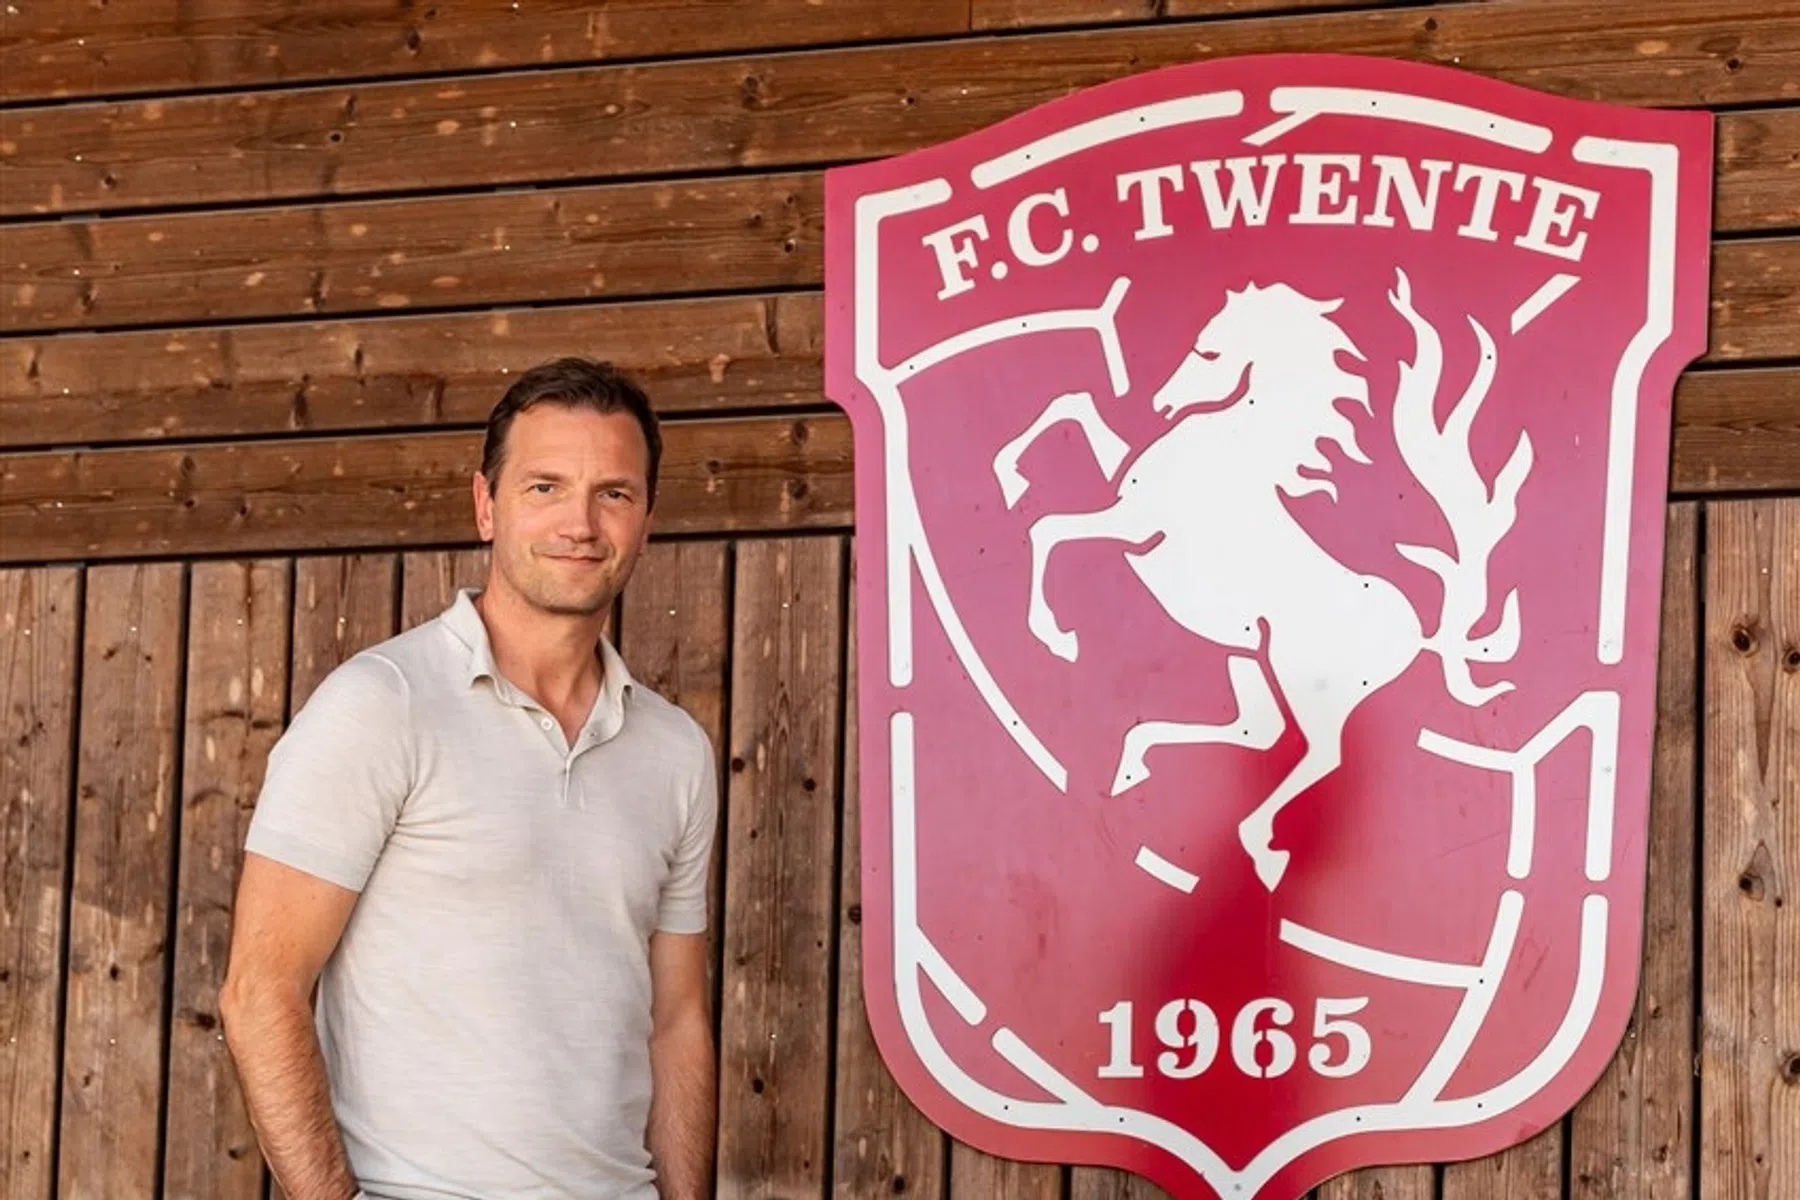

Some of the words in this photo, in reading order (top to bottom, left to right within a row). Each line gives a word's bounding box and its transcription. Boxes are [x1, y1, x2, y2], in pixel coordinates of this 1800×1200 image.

[921, 187, 1099, 301] F.C.
[1116, 153, 1601, 262] TWENTE
[1097, 996, 1373, 1079] 1965
